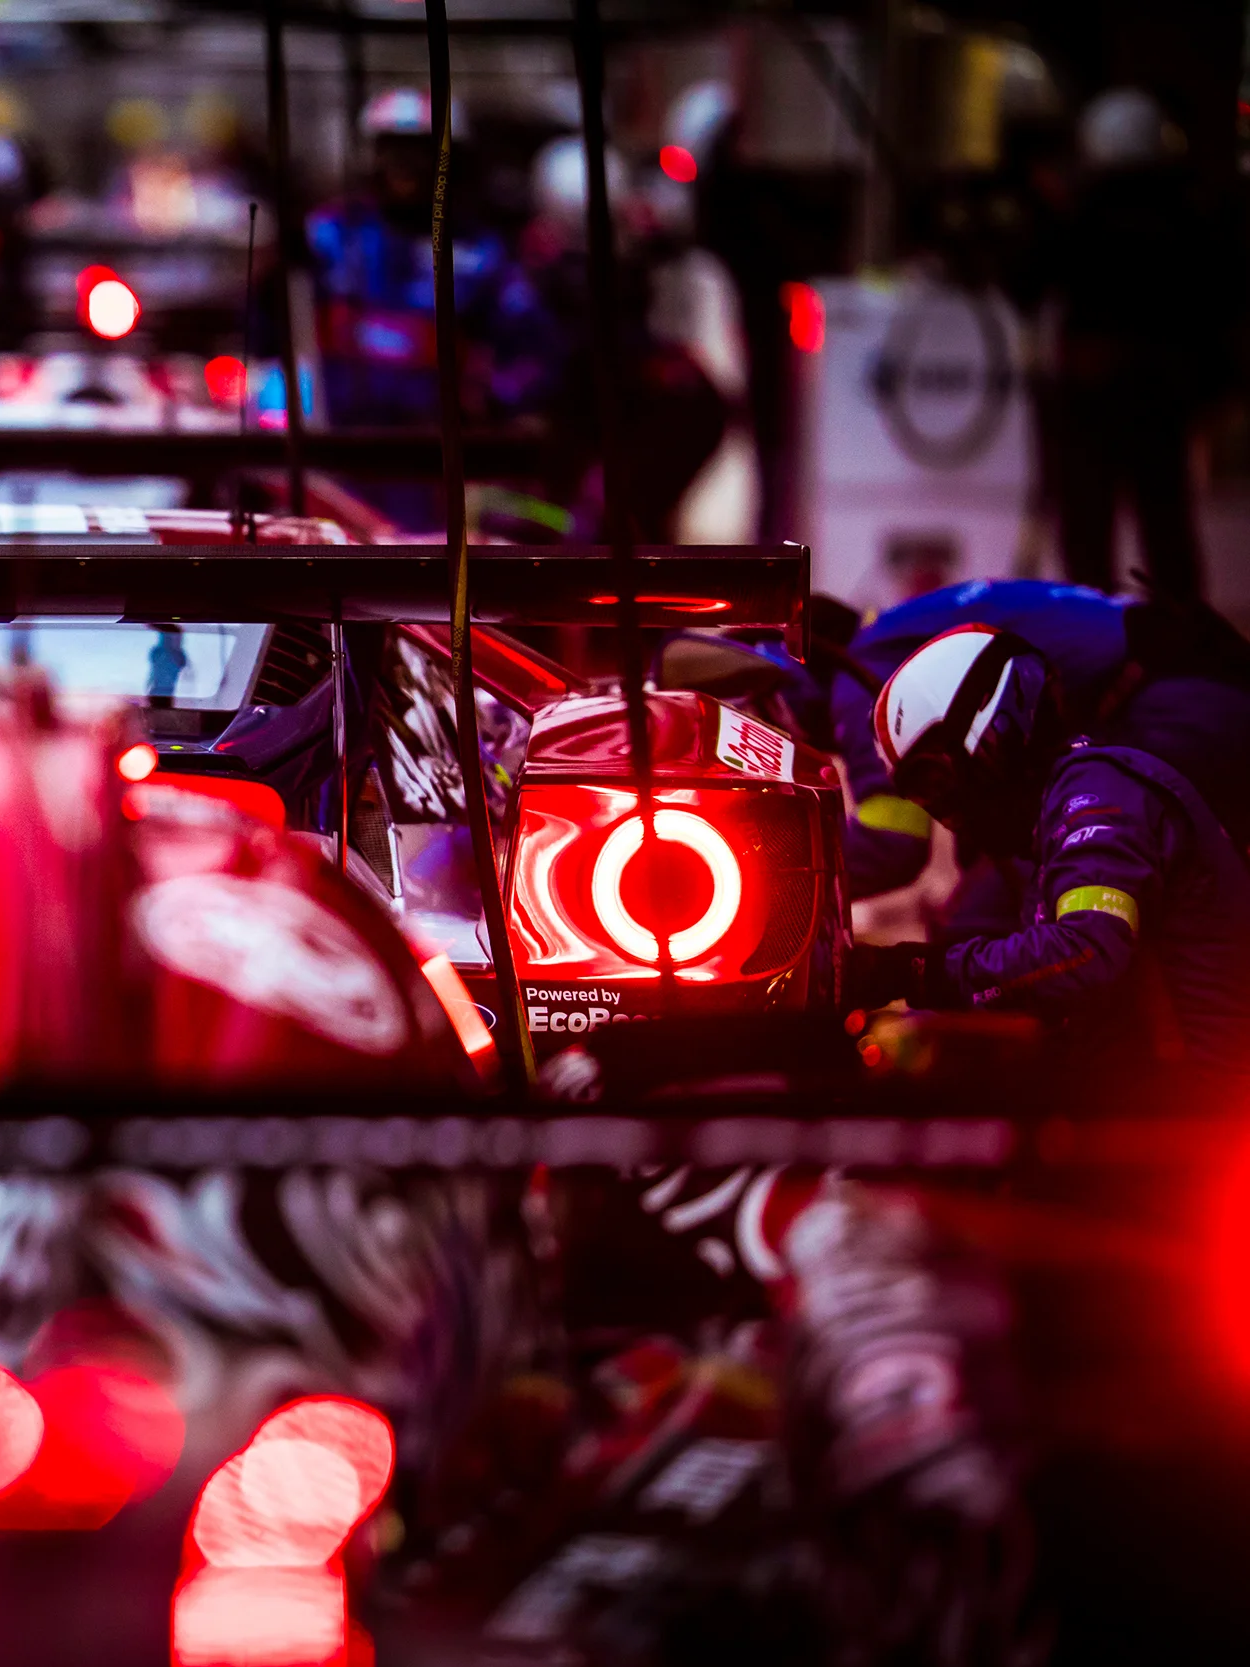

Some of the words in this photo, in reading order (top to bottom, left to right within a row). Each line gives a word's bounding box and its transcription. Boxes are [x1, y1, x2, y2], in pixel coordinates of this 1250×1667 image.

[435, 175, 448, 201] stop
[526, 987, 598, 1001] Powered
[601, 988, 621, 1005] by
